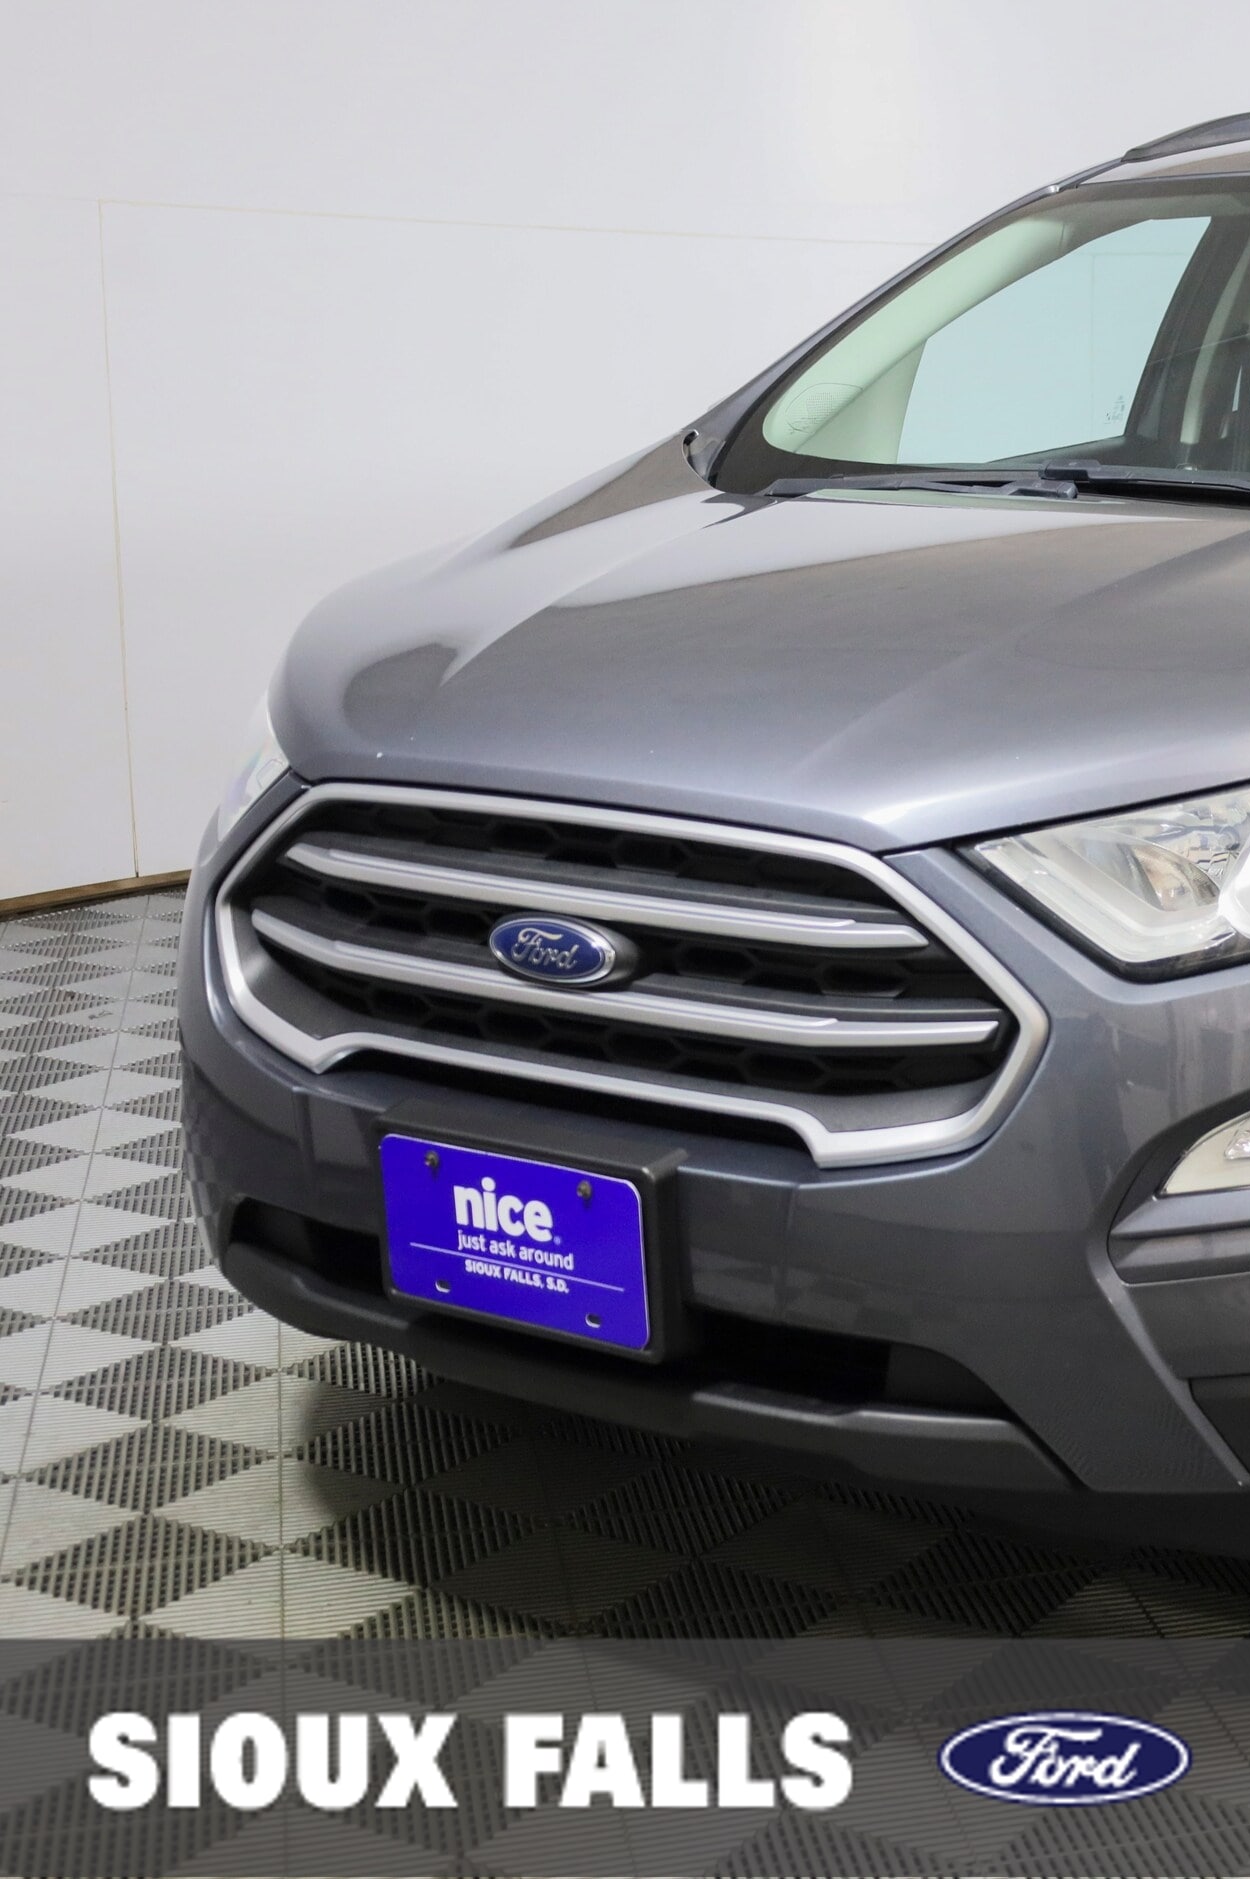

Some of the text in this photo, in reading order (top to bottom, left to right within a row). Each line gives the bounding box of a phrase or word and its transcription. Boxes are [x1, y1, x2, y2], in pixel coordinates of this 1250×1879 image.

[510, 926, 581, 970] Ford
[453, 1176, 554, 1242] nice
[457, 1229, 575, 1271] just ask around
[464, 1258, 570, 1294] SIOUX FALLS, S.D.
